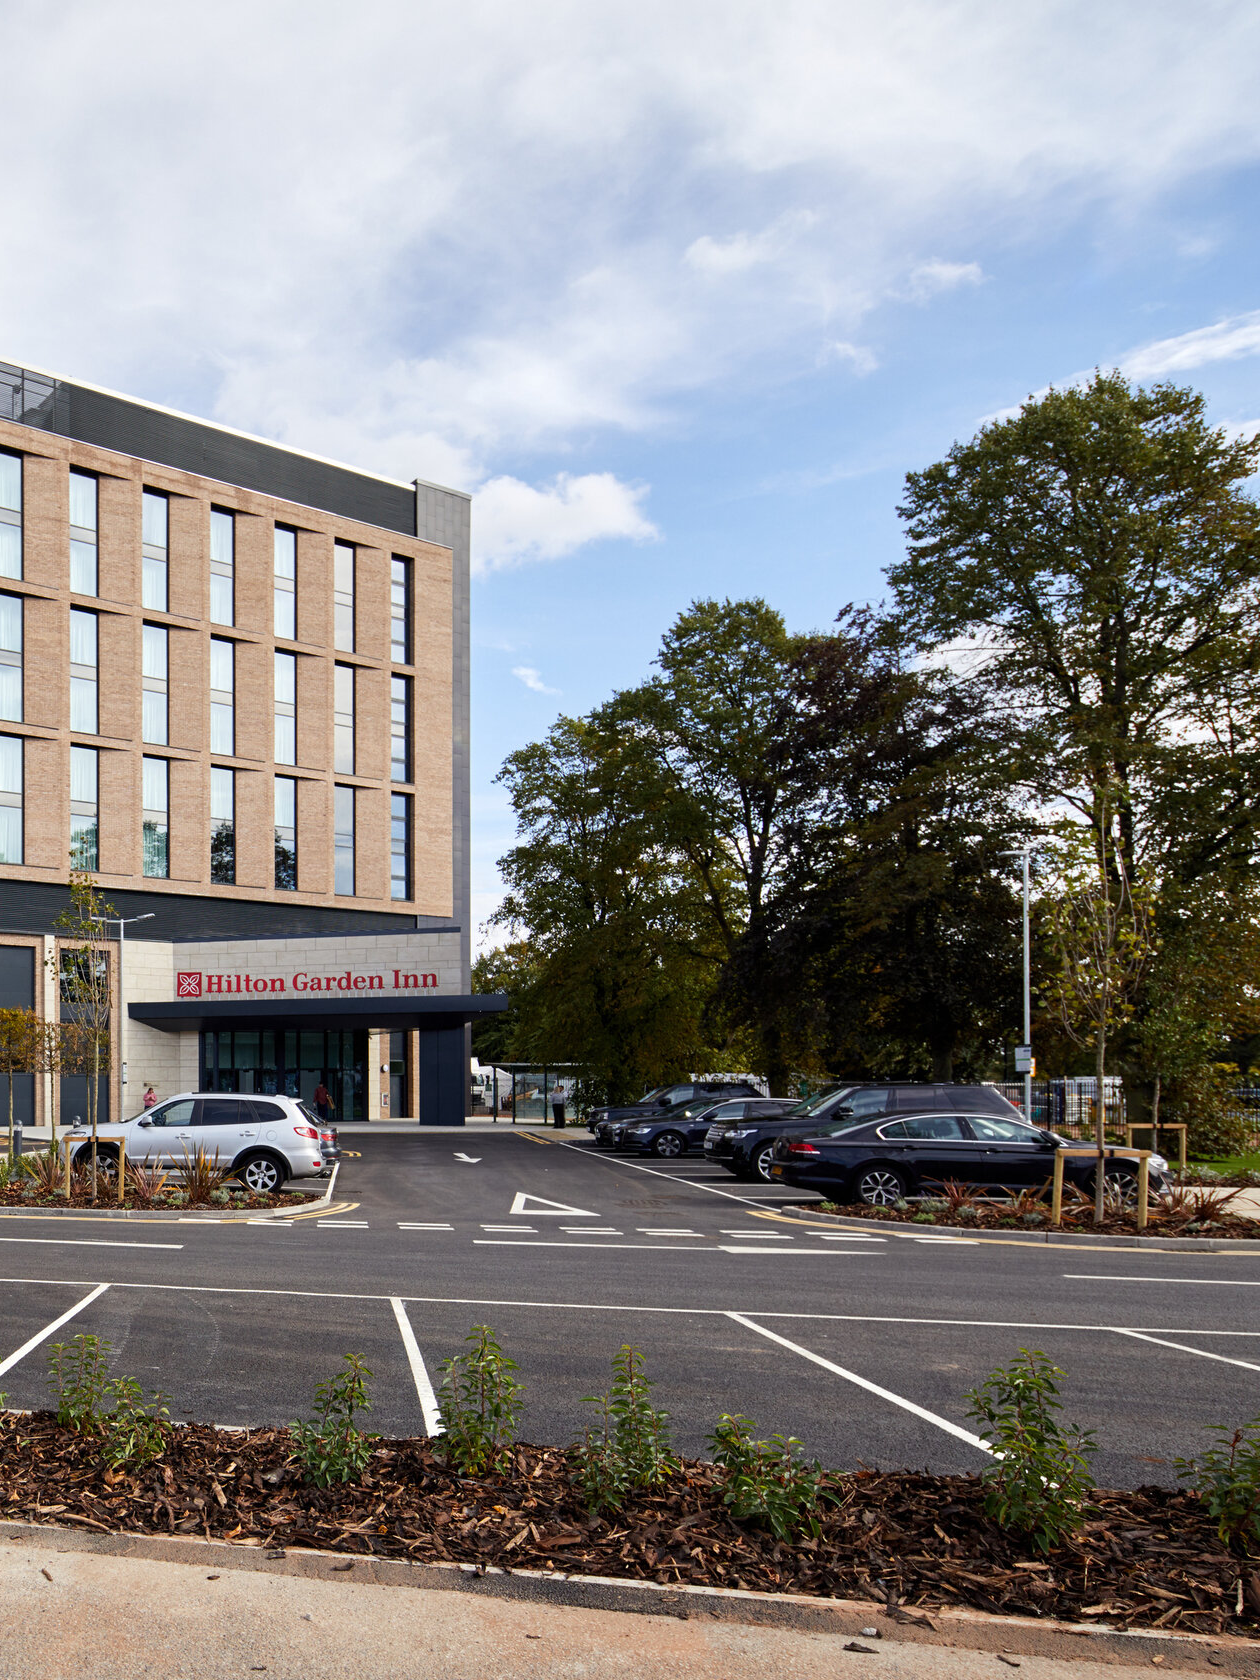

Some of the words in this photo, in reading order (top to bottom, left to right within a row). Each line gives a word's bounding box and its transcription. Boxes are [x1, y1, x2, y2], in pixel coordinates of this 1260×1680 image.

[205, 973, 286, 994] Hilton
[292, 970, 385, 992] Garden
[392, 969, 440, 989] Inn
